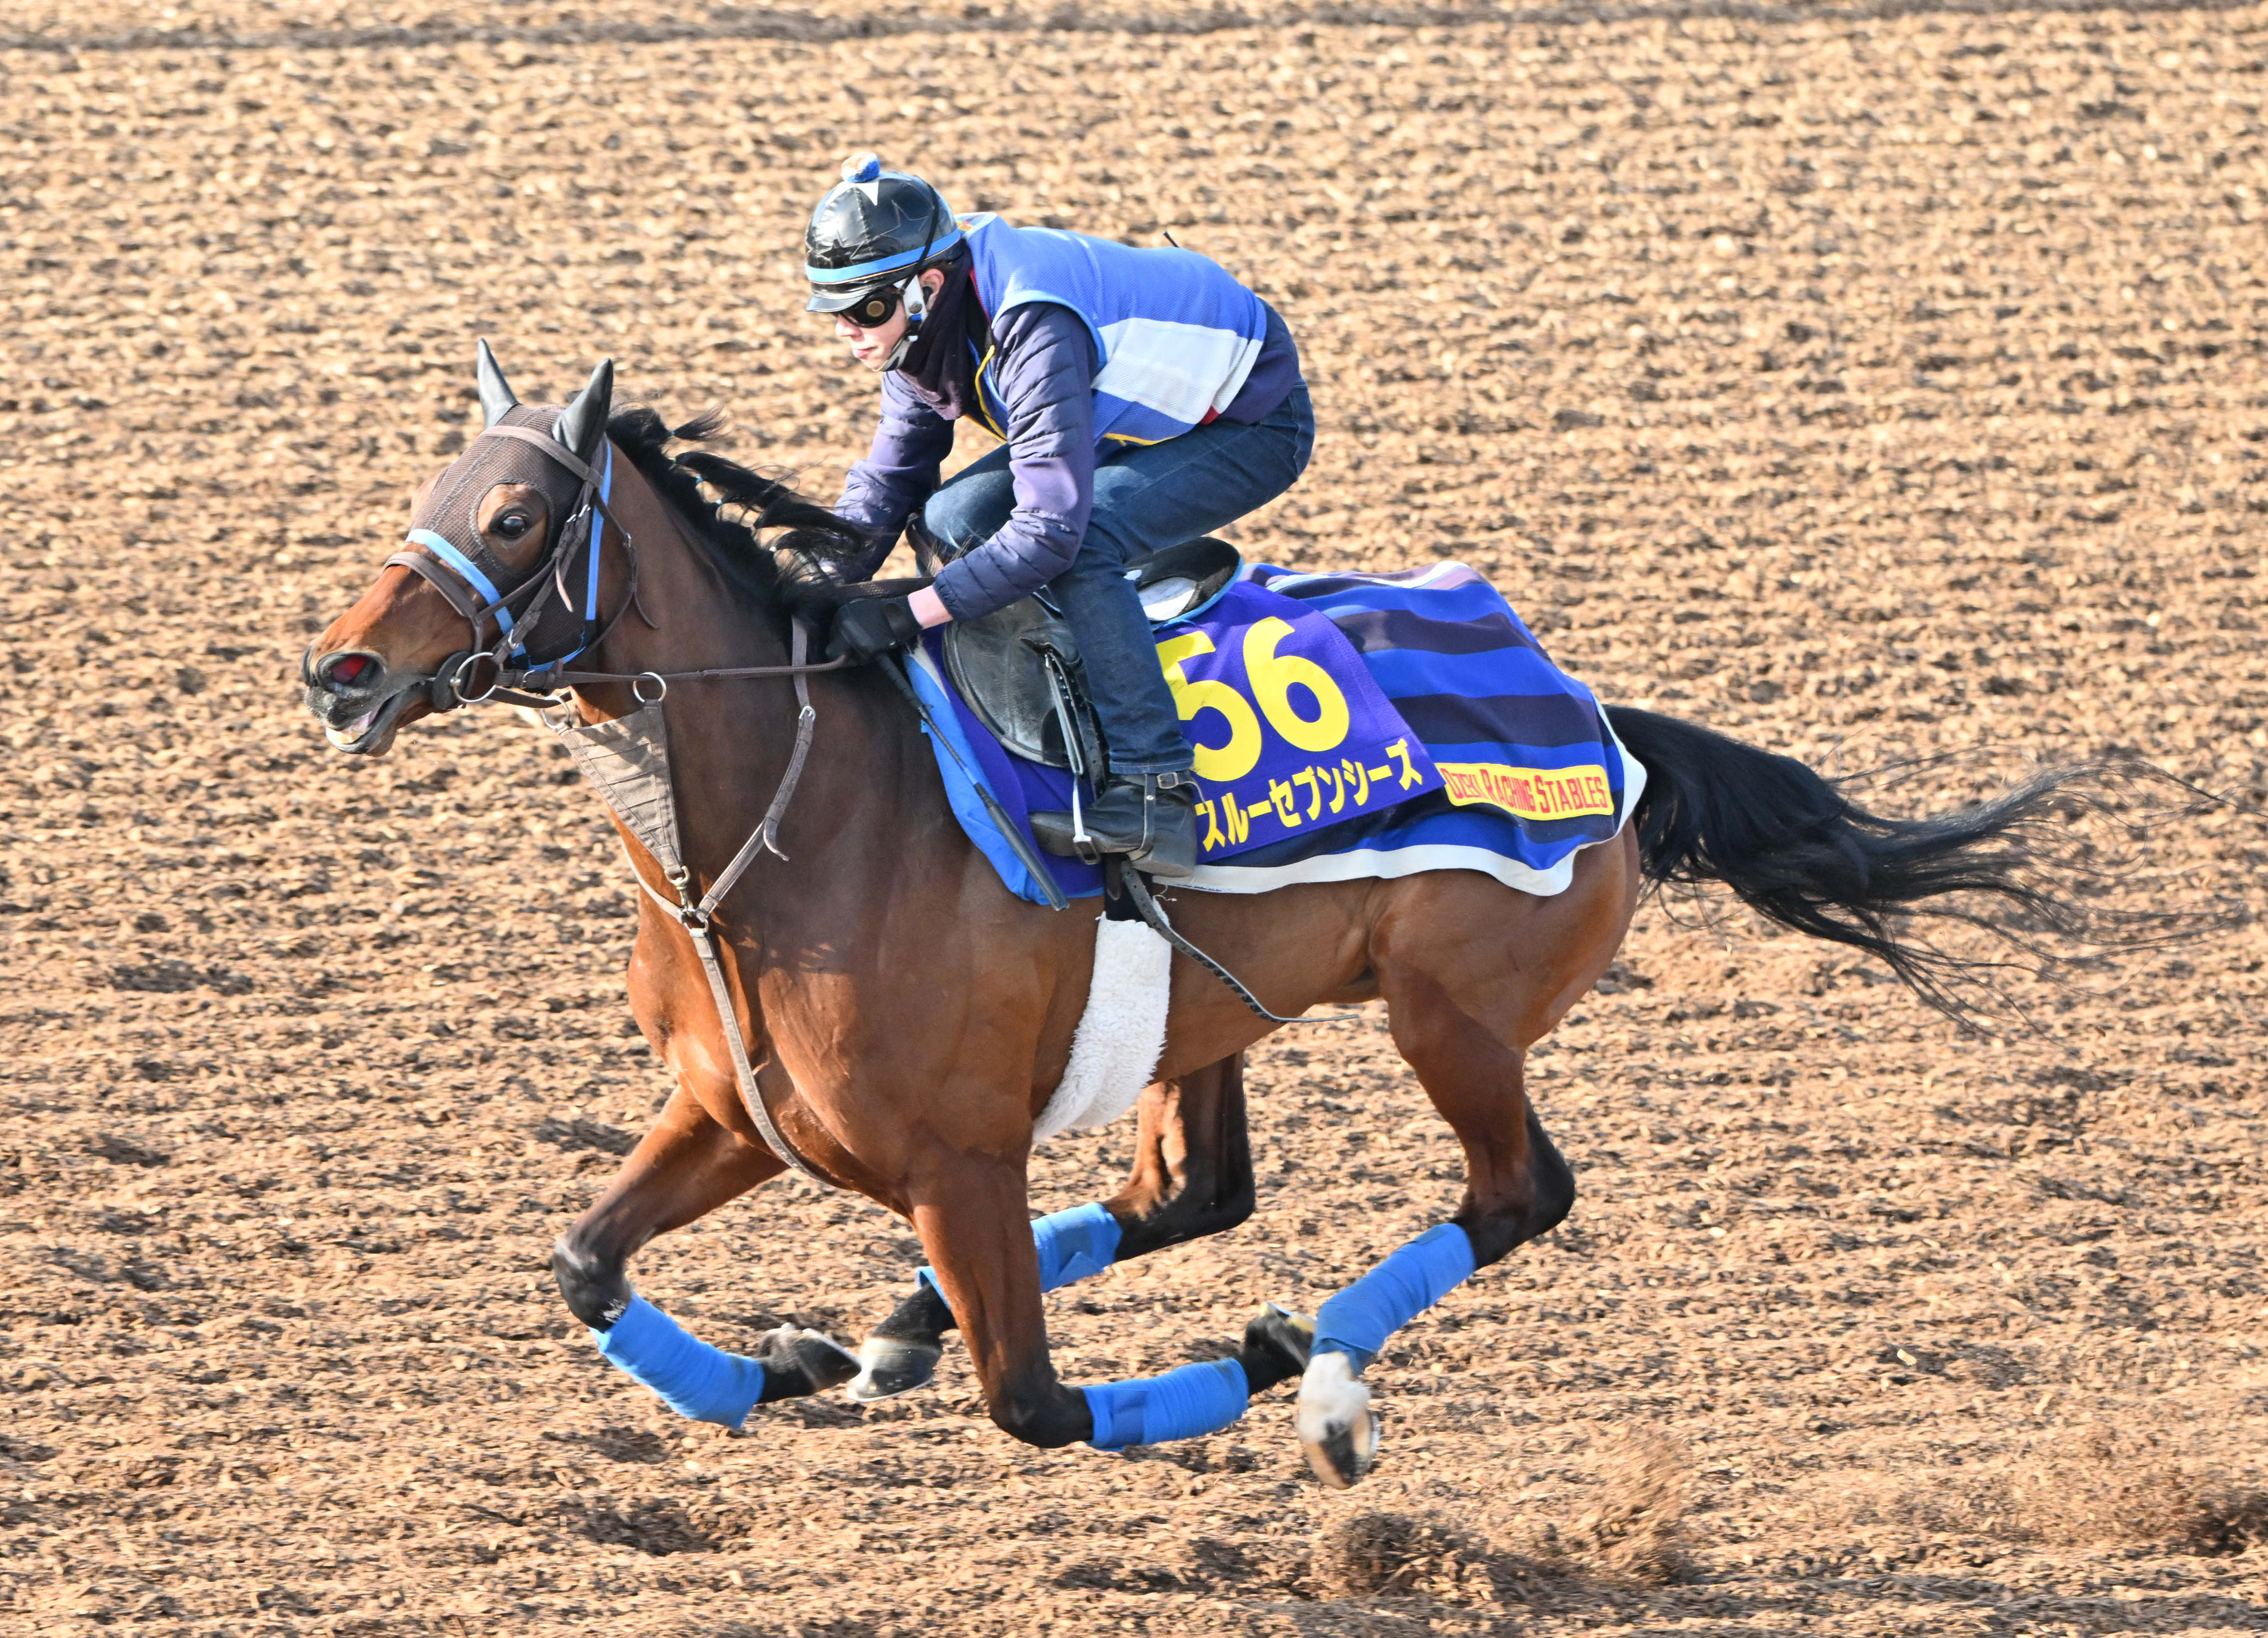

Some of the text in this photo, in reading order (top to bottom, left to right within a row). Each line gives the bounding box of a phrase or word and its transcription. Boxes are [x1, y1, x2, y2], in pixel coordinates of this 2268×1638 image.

[1157, 616, 1350, 781] 56
[1195, 739, 1422, 852] スルーセブンシーズ
[1534, 775, 1608, 813] STABLES
